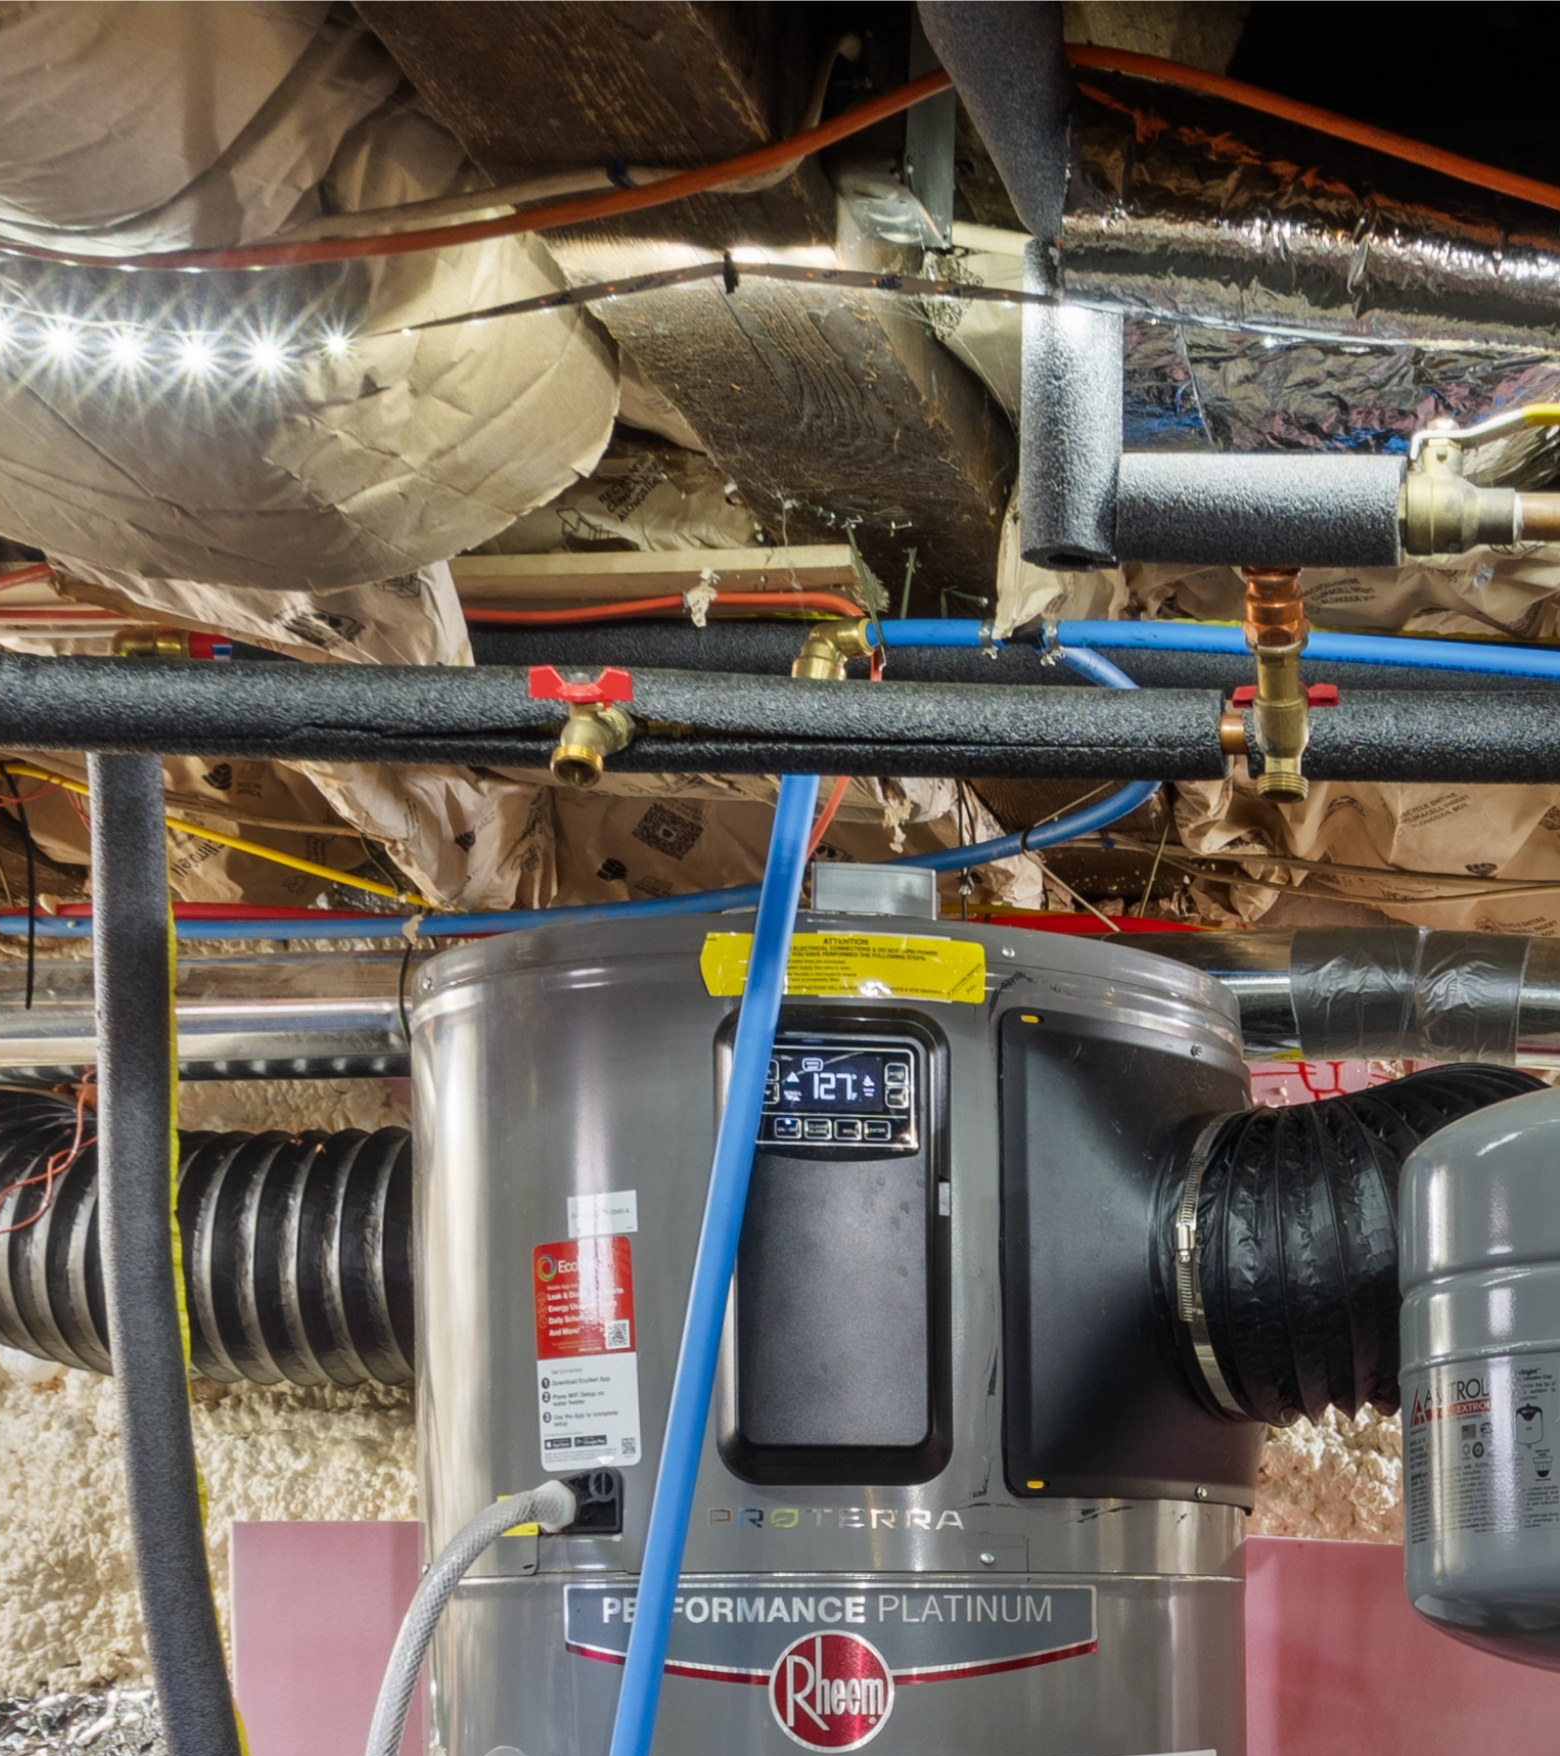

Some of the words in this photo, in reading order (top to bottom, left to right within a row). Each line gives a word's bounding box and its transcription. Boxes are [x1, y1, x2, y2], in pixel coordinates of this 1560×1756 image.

[708, 1508, 964, 1530] PROTERRA
[602, 1596, 866, 1624] PEFORMANCE
[878, 1595, 1052, 1623] PLATINUM
[786, 1636, 884, 1731] Rheem
